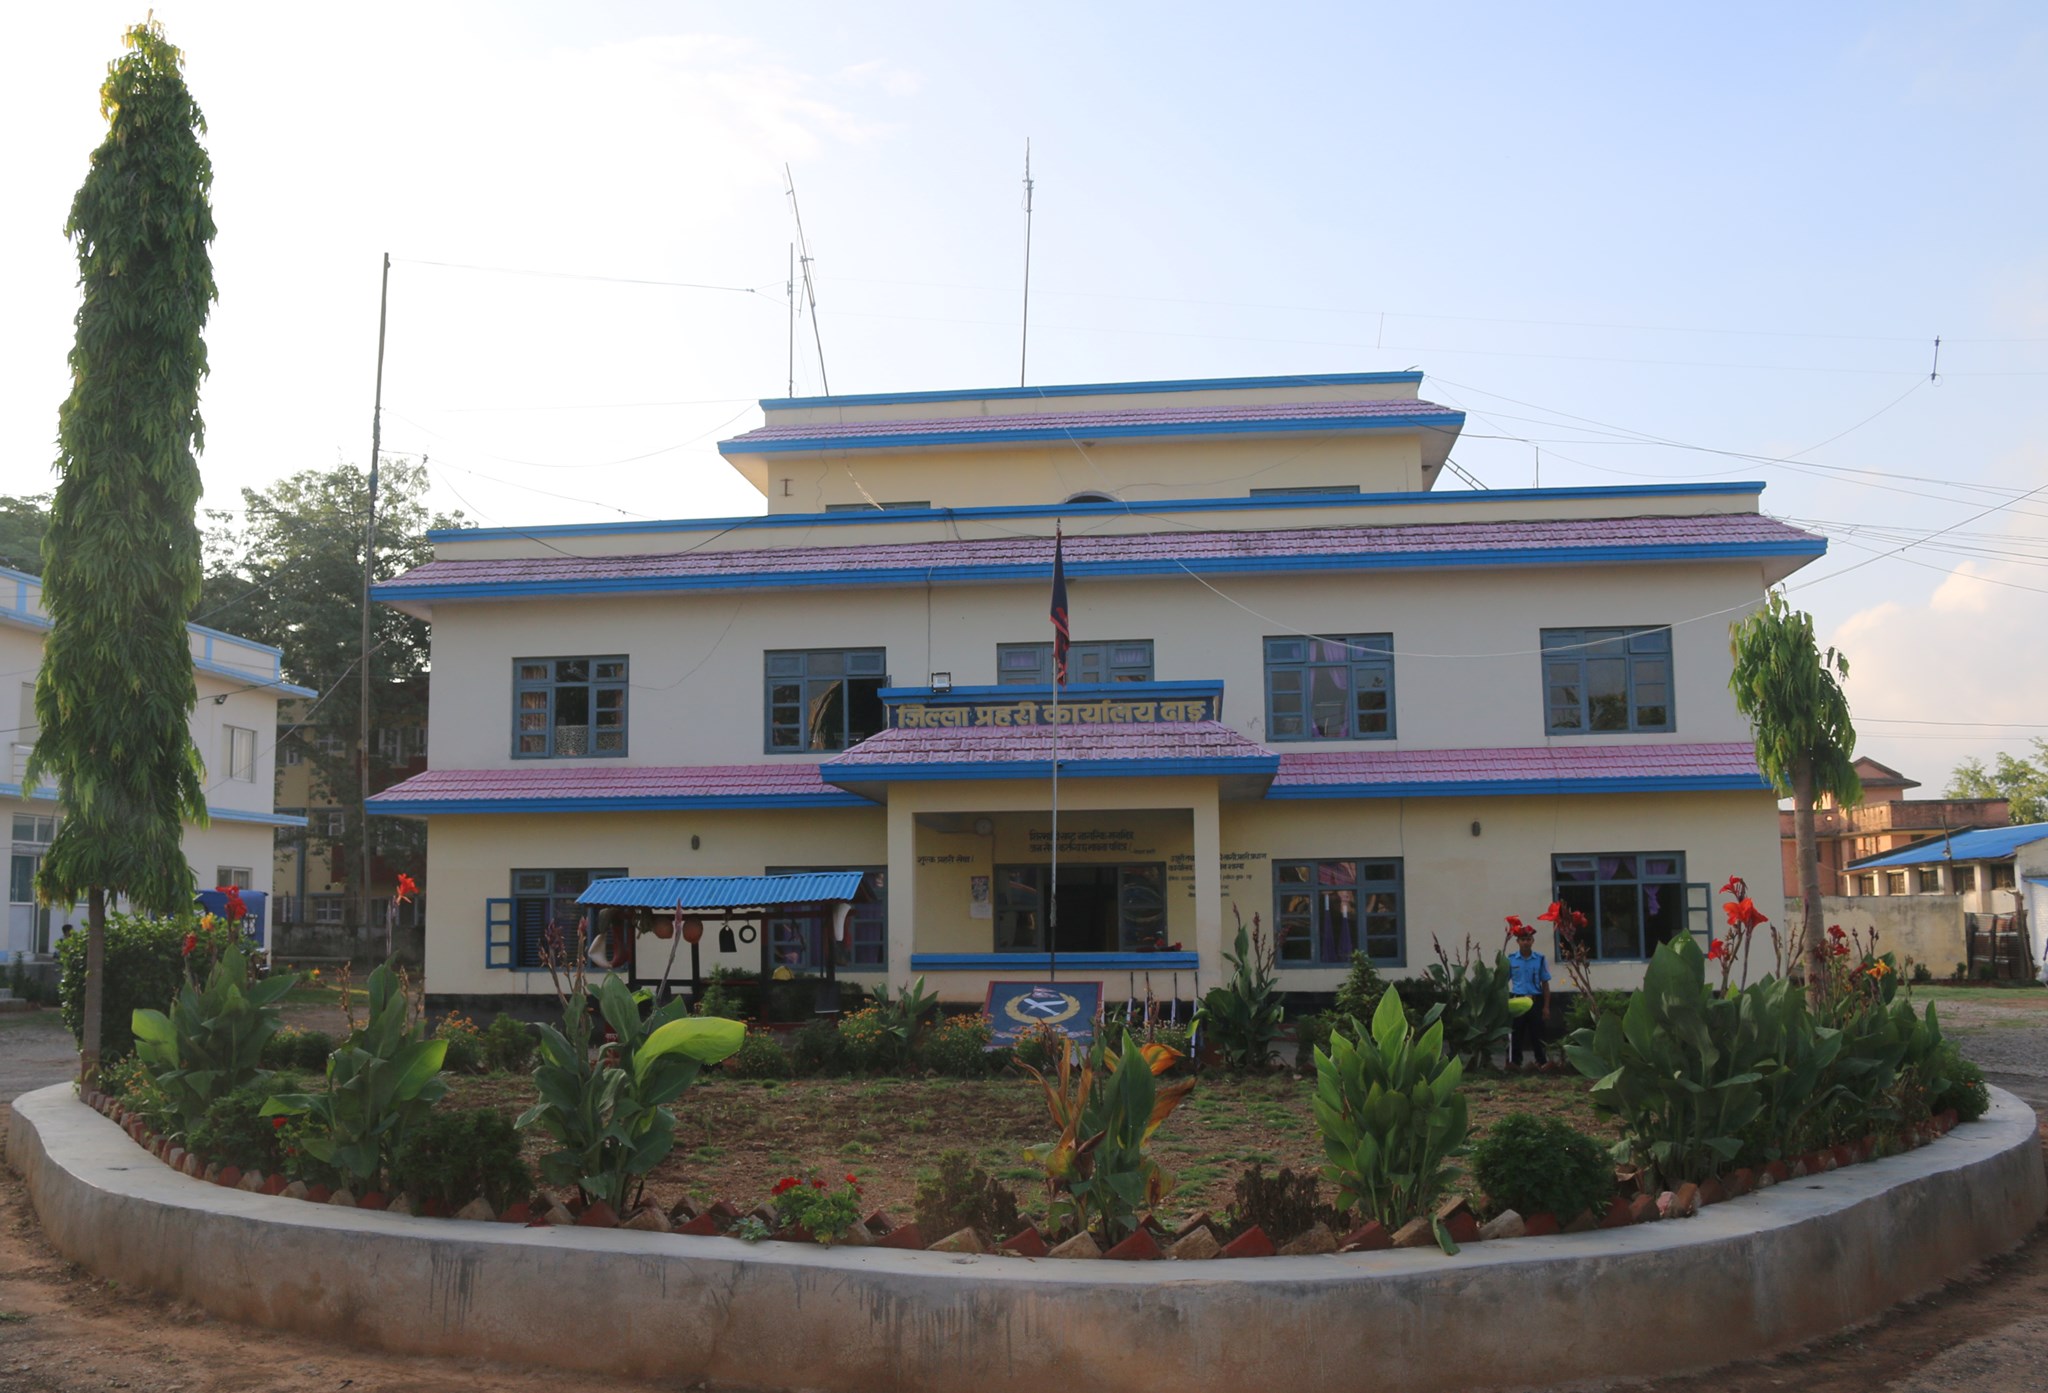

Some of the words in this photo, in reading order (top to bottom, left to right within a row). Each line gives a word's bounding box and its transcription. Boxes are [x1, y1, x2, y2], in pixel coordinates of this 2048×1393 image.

[896, 704, 970, 728] जिल्ला
[975, 702, 1039, 726] प्रहरी
[1042, 699, 1157, 724] कार्यालय
